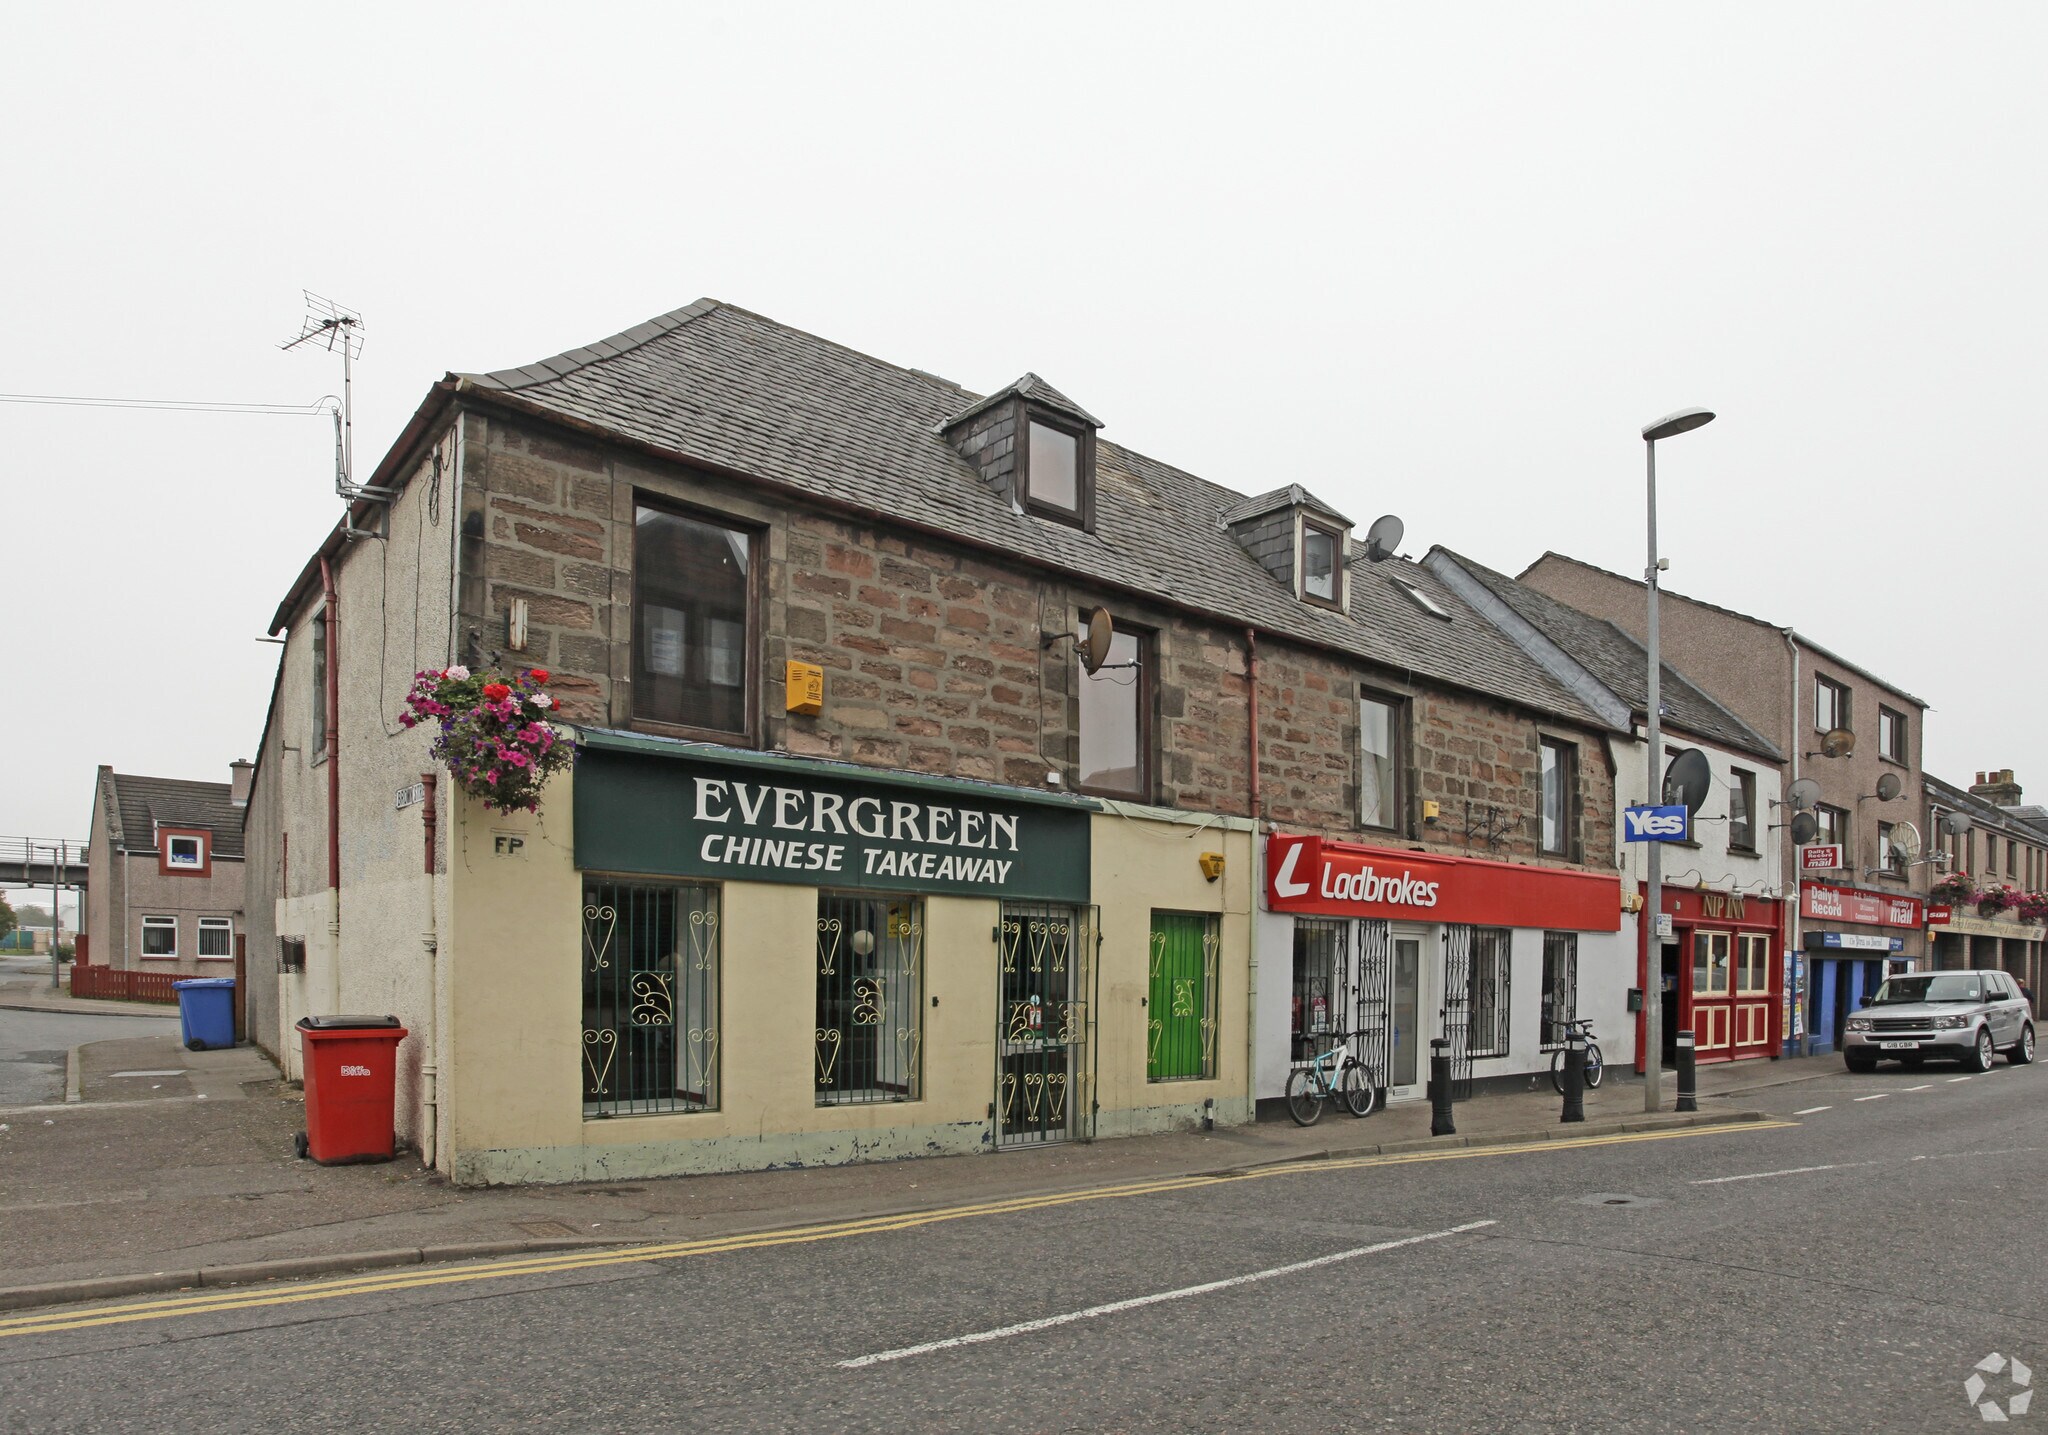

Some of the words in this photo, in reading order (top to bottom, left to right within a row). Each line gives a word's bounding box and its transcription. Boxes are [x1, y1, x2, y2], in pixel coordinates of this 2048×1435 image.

[692, 777, 1019, 851] EVERGREEN
[1625, 810, 1684, 835] Yes
[700, 834, 845, 872] CHINESE
[863, 848, 1012, 884] TAKEAWAY
[1808, 858, 1832, 867] mail
[1320, 862, 1439, 907] Ladbrokes
[1811, 886, 1832, 904] Daily
[1703, 895, 1724, 917] NIP
[1726, 897, 1745, 919] INN
[1811, 900, 1842, 916] Record
[1890, 902, 1914, 924] mail
[1892, 899, 1910, 909] sunday
[341, 1065, 370, 1076] Biffa
